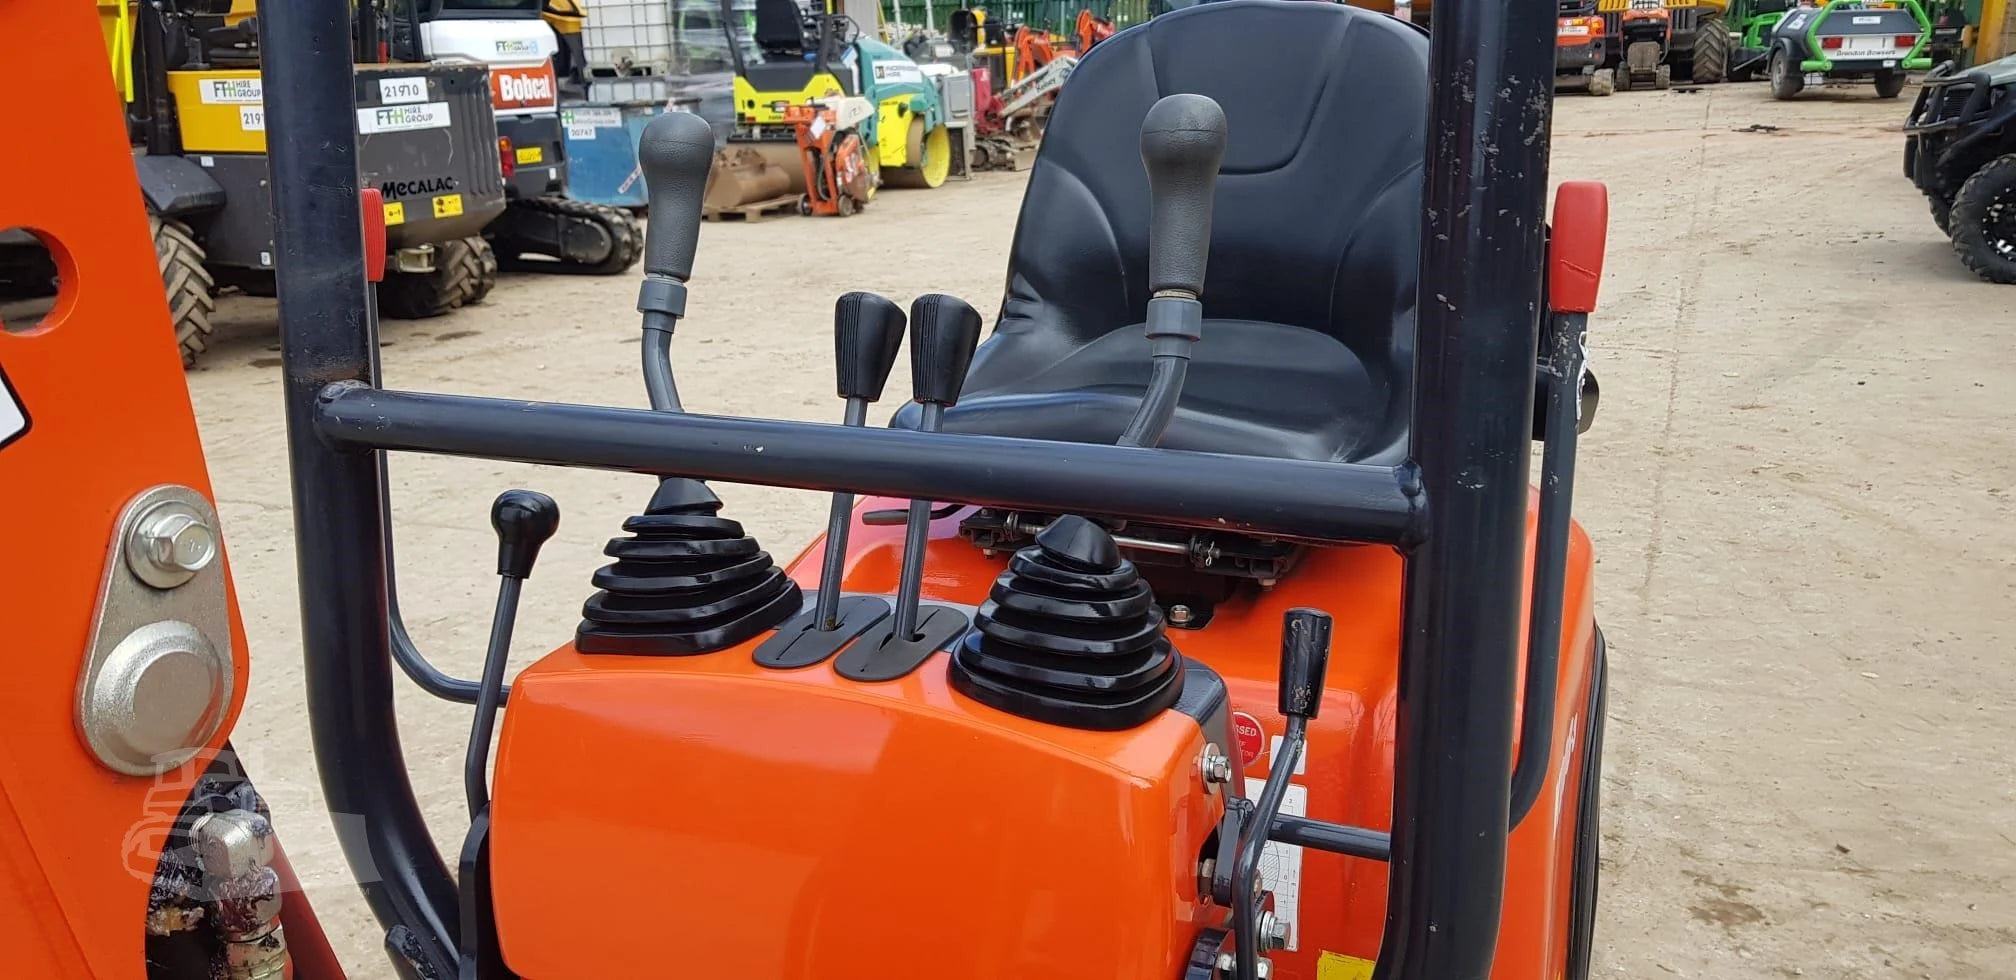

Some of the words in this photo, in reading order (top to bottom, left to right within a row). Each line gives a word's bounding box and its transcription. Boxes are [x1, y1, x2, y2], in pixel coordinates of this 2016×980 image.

[213, 81, 237, 98] FTH
[237, 89, 261, 98] GROUP
[499, 73, 552, 101] Bobcat
[243, 112, 264, 125] 219
[405, 114, 433, 124] GROUP
